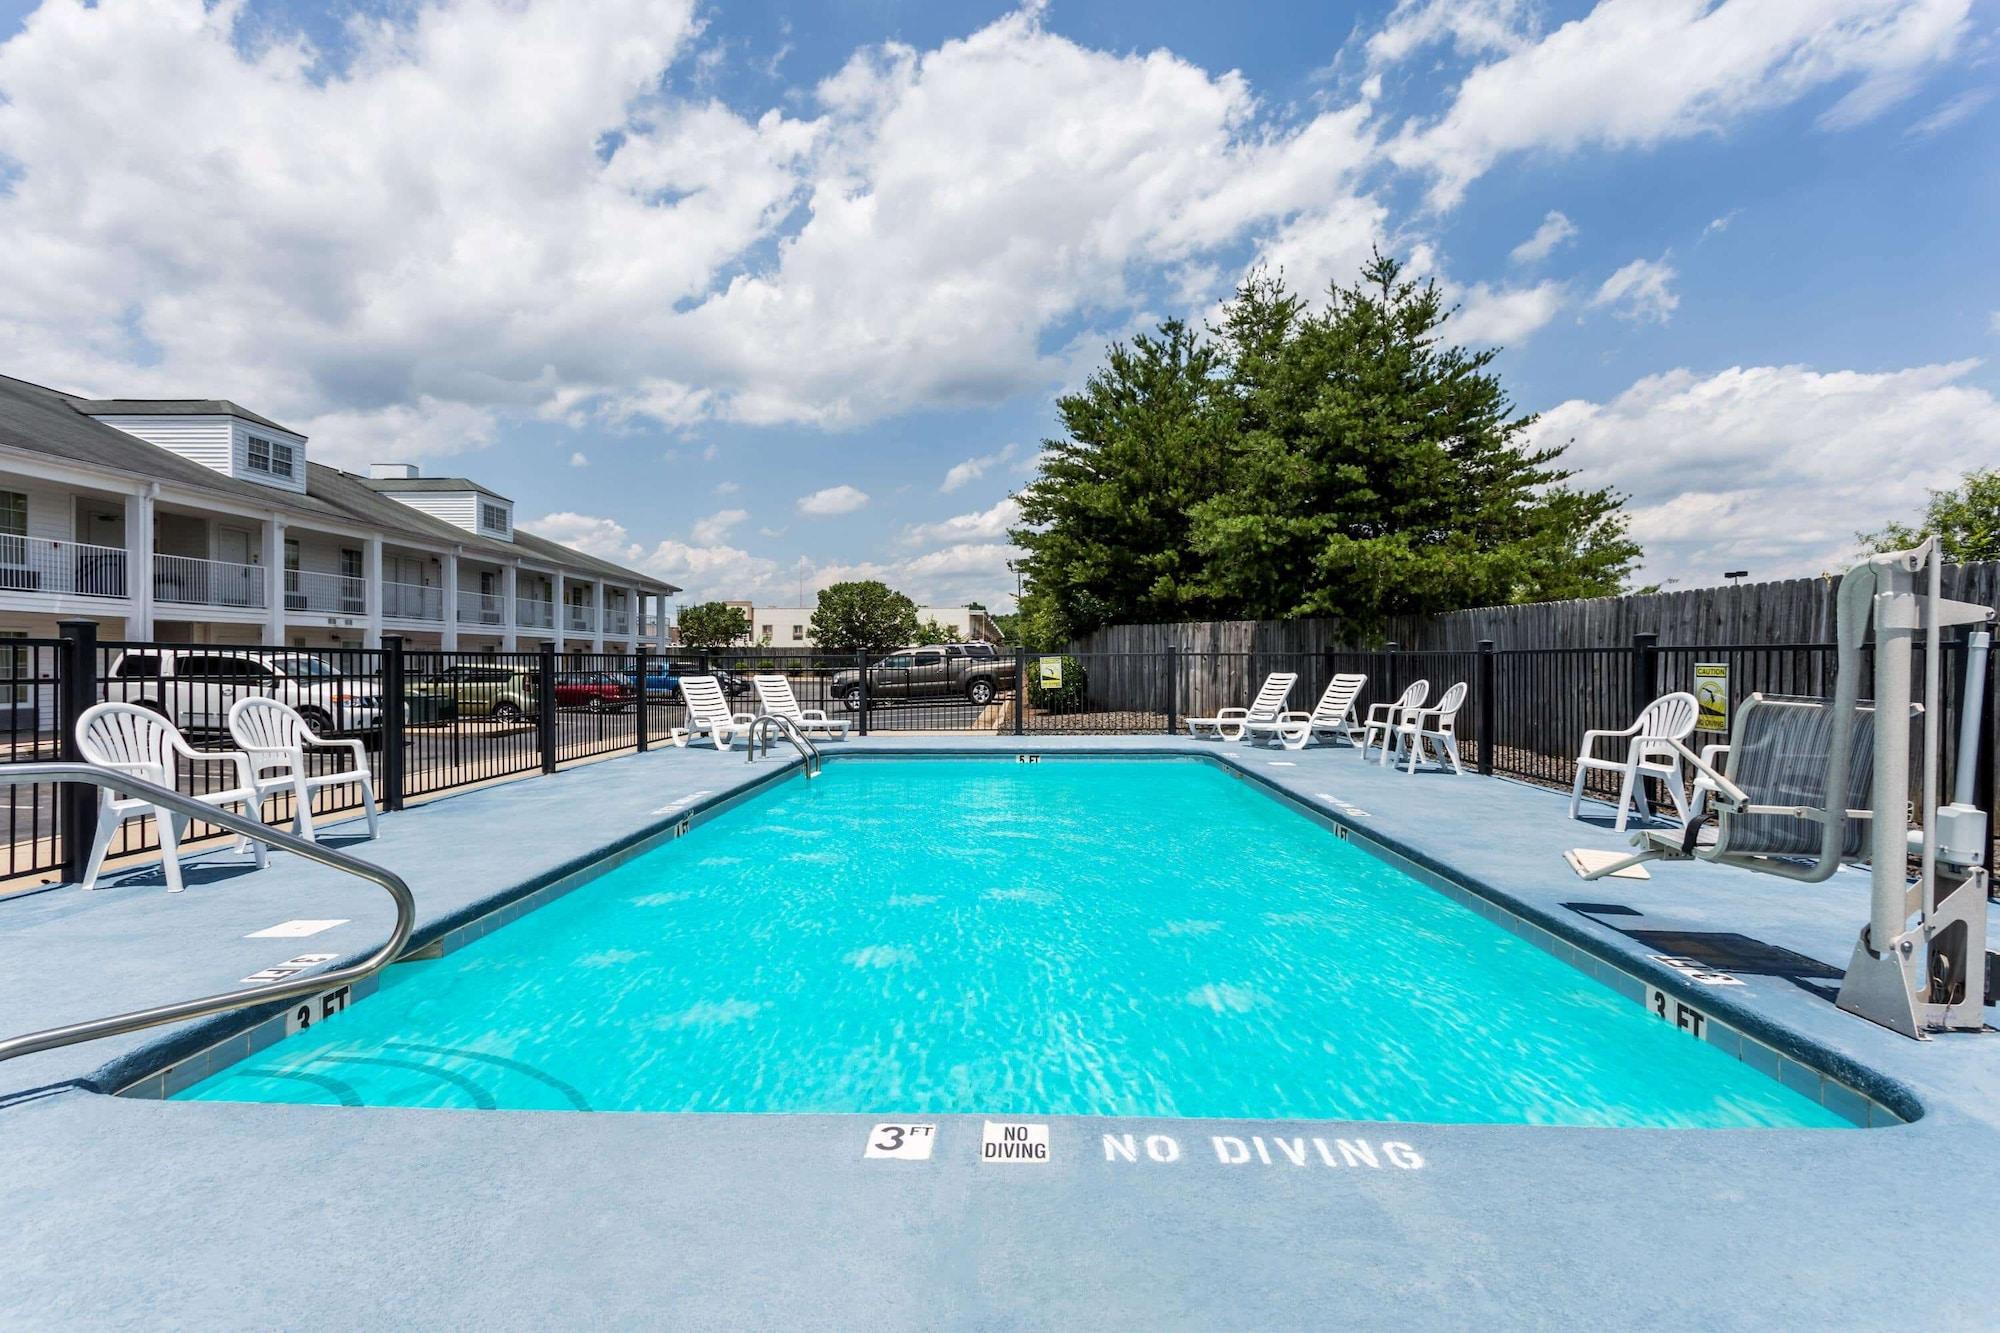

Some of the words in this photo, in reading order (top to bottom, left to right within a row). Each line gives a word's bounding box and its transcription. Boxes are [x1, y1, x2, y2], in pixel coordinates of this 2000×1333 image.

[1029, 755, 1040, 764] FT
[322, 986, 349, 1022] FT
[1677, 1002, 1705, 1040] FT
[875, 1126, 906, 1151] 3
[909, 1126, 934, 1136] FT
[1003, 1126, 1028, 1141] NO
[984, 1142, 1046, 1159] DIVING
[1102, 1133, 1181, 1163] NO
[1211, 1135, 1425, 1170] DIVING
